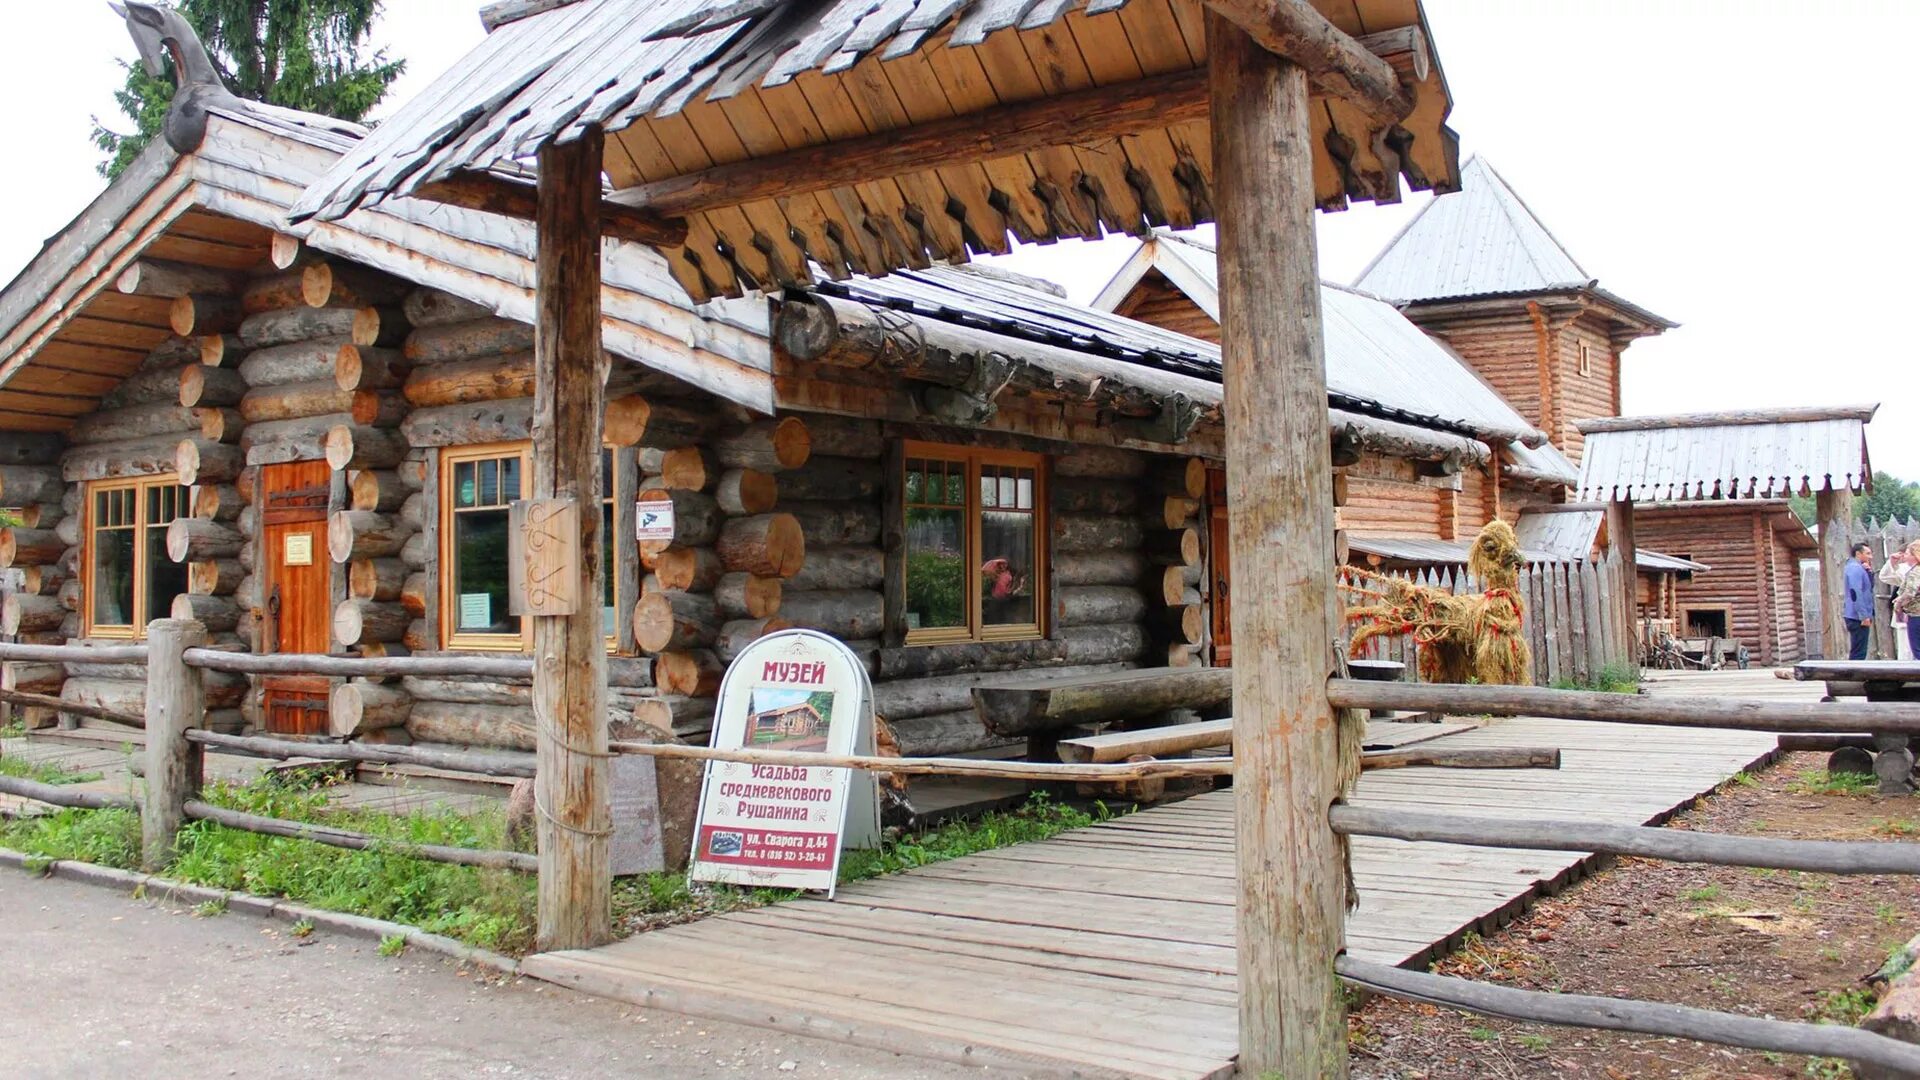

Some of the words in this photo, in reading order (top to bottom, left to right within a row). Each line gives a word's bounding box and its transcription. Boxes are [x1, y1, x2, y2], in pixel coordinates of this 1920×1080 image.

[762, 661, 826, 684] МУЗЕЙ
[751, 763, 807, 781] Усадьба
[720, 783, 832, 802] средневекового
[737, 801, 808, 821] Рушанина
[746, 833, 761, 845] ул.
[765, 833, 804, 848] Сварога
[744, 849, 758, 858] тел.
